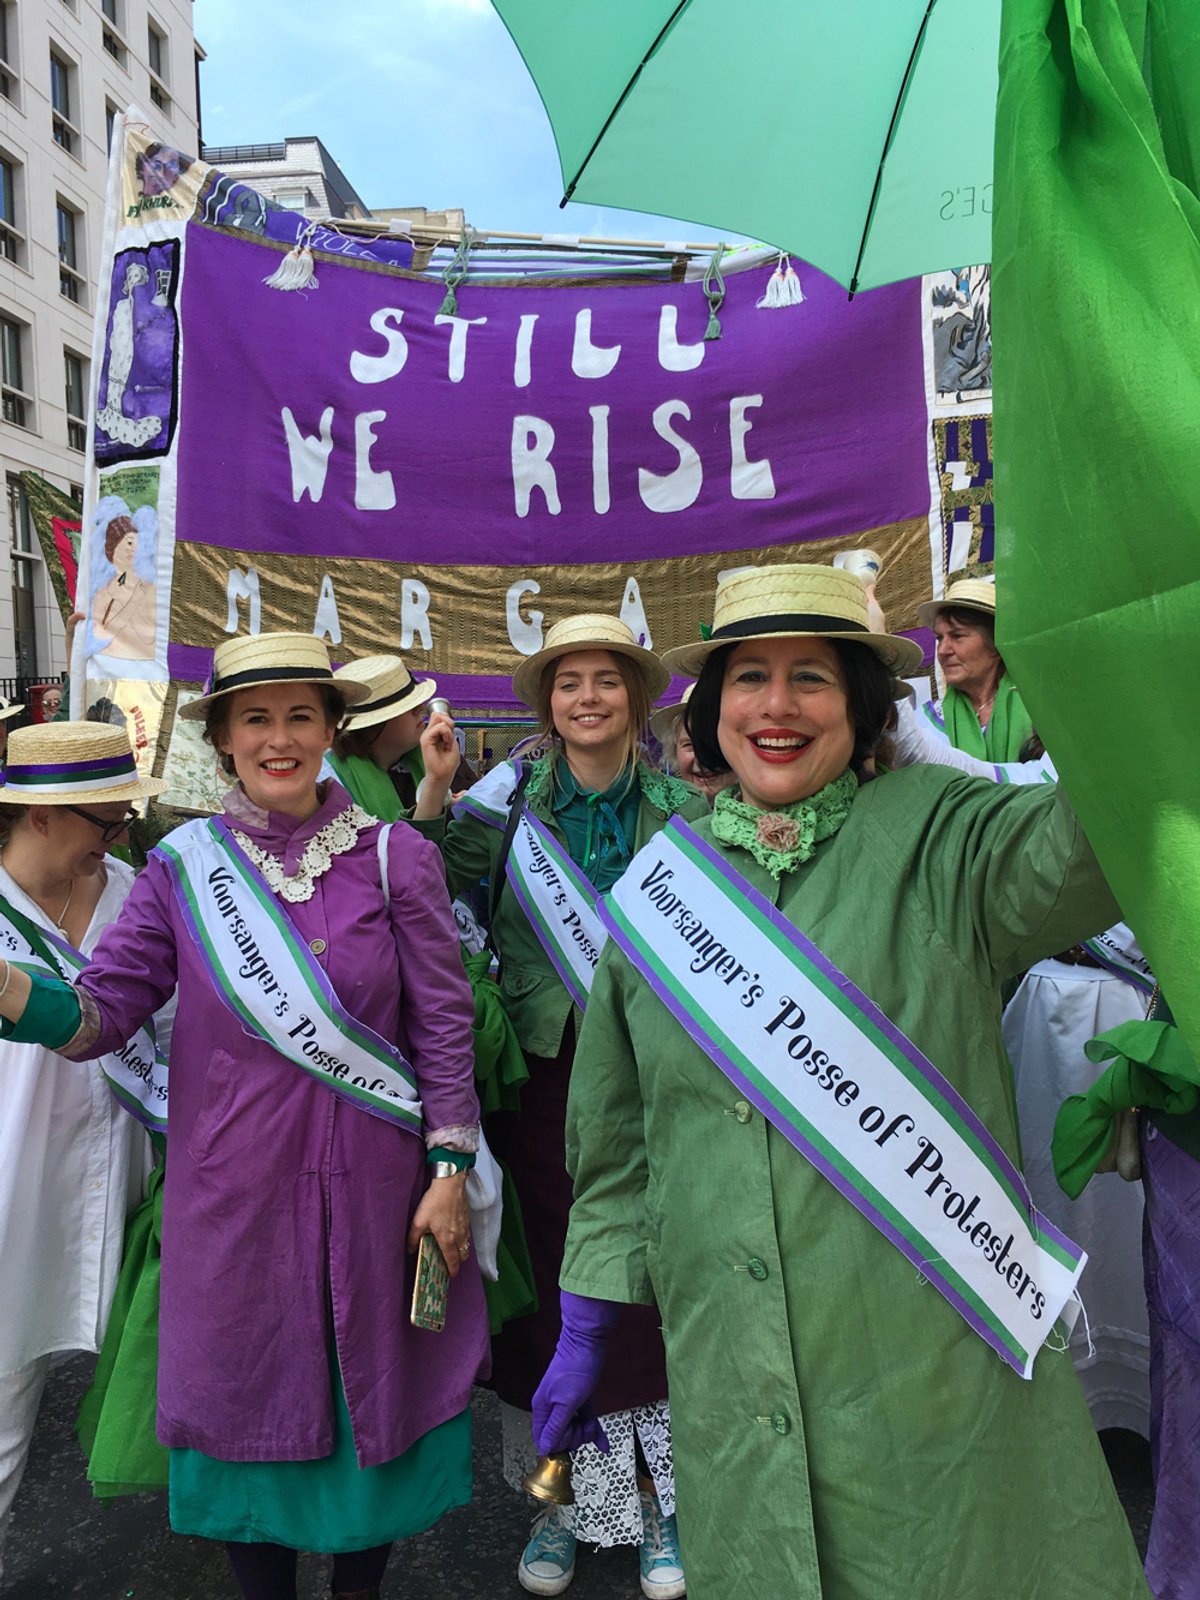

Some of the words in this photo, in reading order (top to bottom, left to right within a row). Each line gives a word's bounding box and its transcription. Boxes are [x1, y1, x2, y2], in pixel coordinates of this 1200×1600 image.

[350, 304, 706, 388] STILL
[281, 406, 397, 511] WE
[511, 393, 777, 518] RISE
[225, 556, 851, 656] MARGA
[208, 866, 290, 1018] Voorsanger's
[287, 1013, 351, 1080] Posse
[639, 859, 765, 1009] Voorsanger's
[763, 995, 860, 1108] Posse
[858, 1113, 916, 1149] of
[904, 1136, 1047, 1321] Protesters
